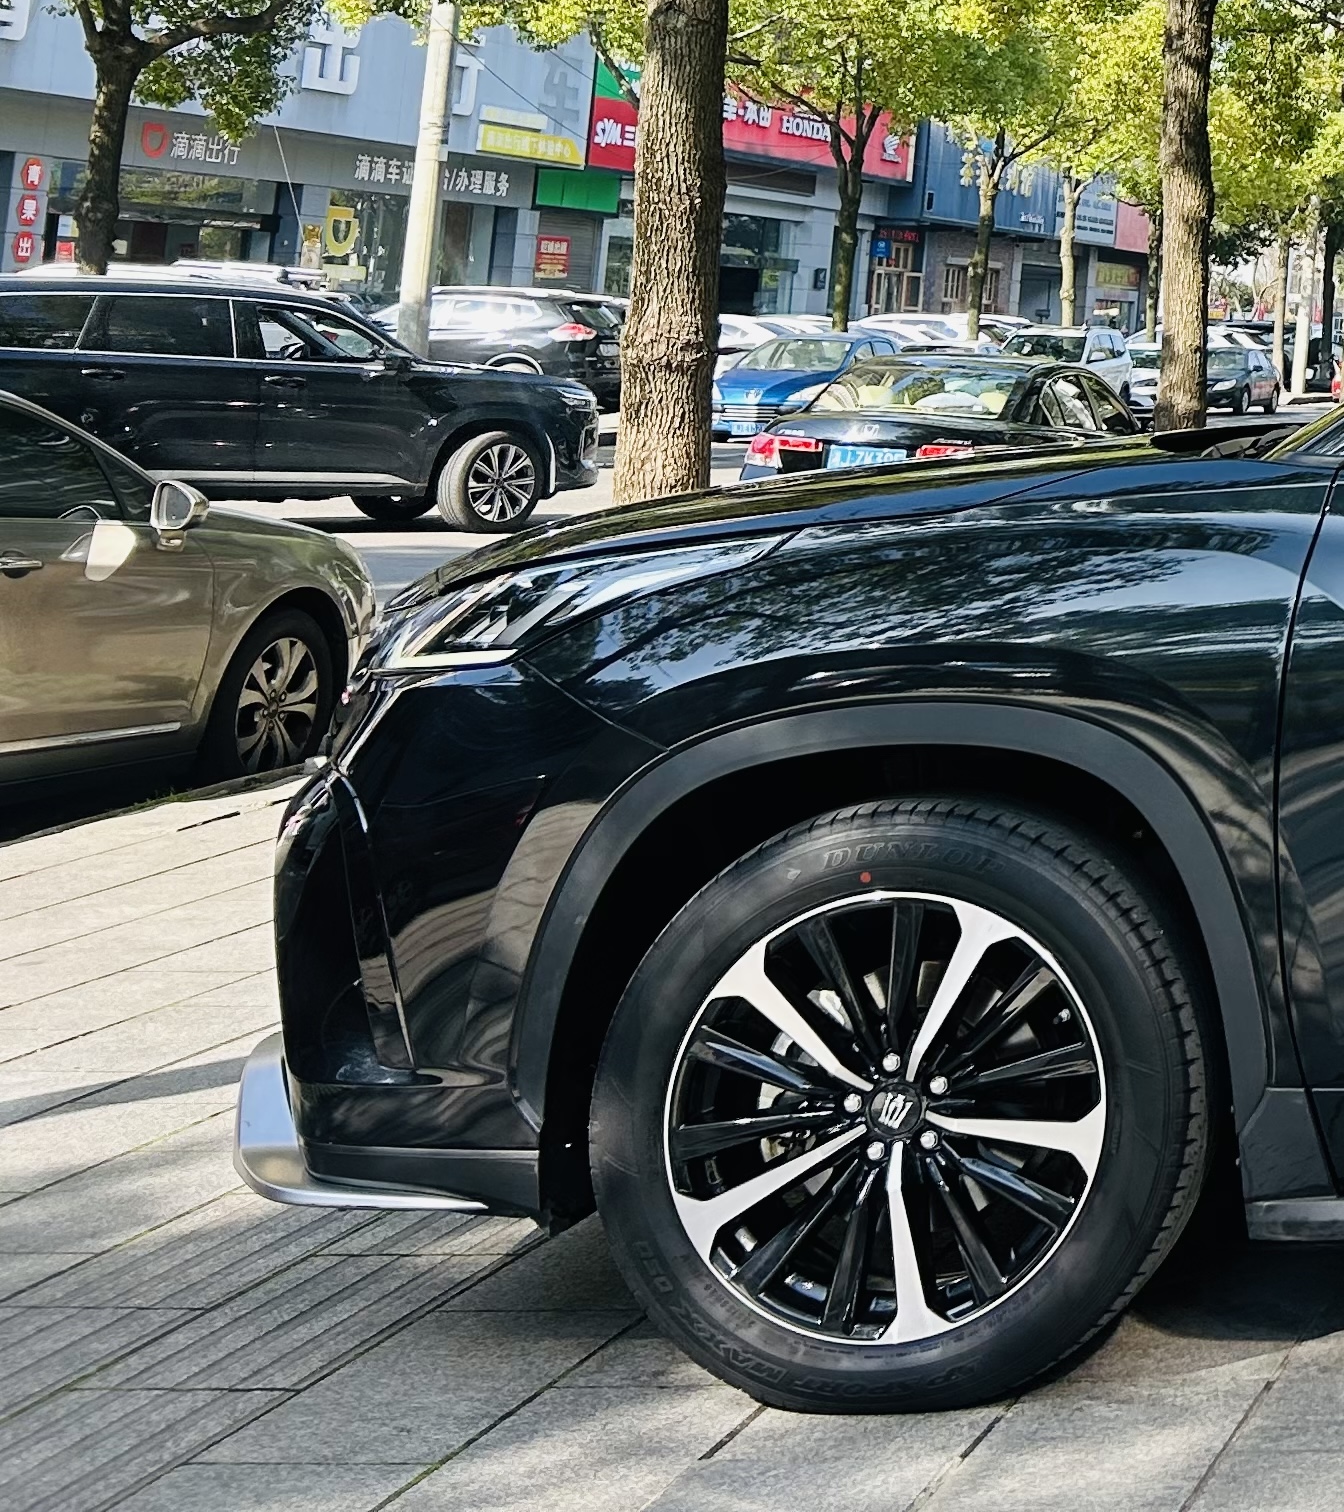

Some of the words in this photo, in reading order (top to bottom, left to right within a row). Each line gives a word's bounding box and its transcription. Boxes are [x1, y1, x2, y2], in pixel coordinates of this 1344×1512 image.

[170, 131, 241, 166] 滴滴出行
[594, 118, 622, 148] SYM
[354, 154, 509, 198] 滴滴车证/办理服务
[819, 841, 1007, 875] DUNLOP
